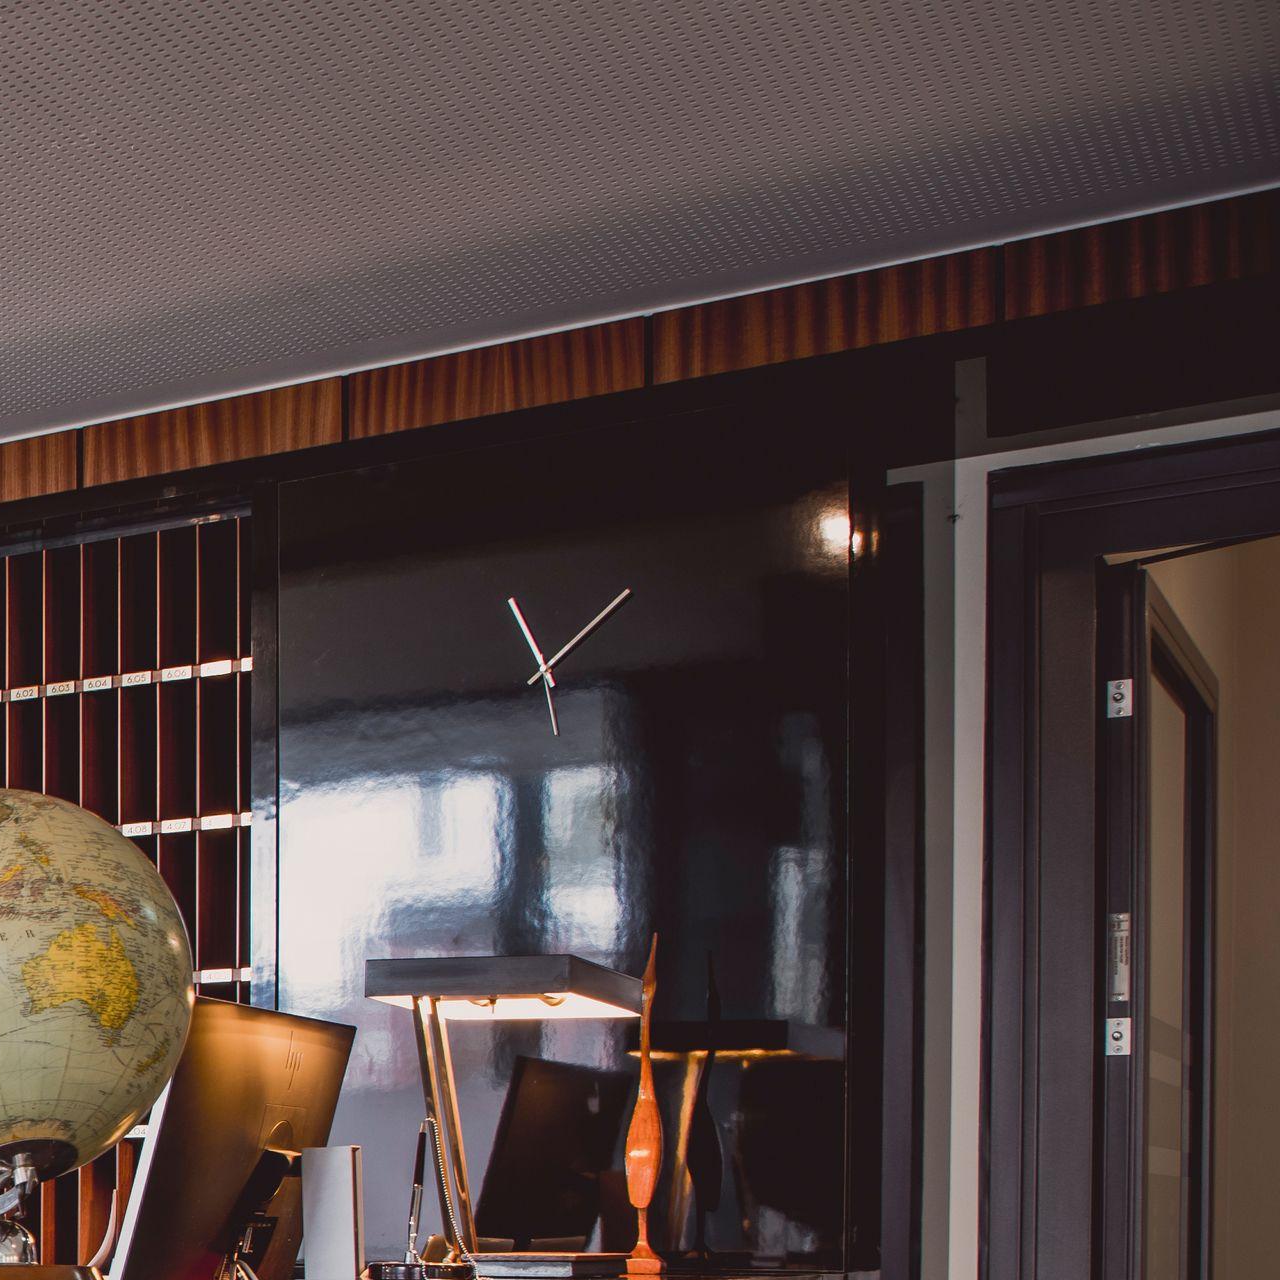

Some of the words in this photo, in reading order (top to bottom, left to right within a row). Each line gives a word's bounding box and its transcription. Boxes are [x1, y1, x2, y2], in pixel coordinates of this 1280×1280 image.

[87, 679, 107, 690] 6.04
[126, 673, 147, 685] 6.05
[15, 688, 34, 699] 6.02
[51, 683, 70, 694] 6.03
[127, 824, 147, 835] 4.08
